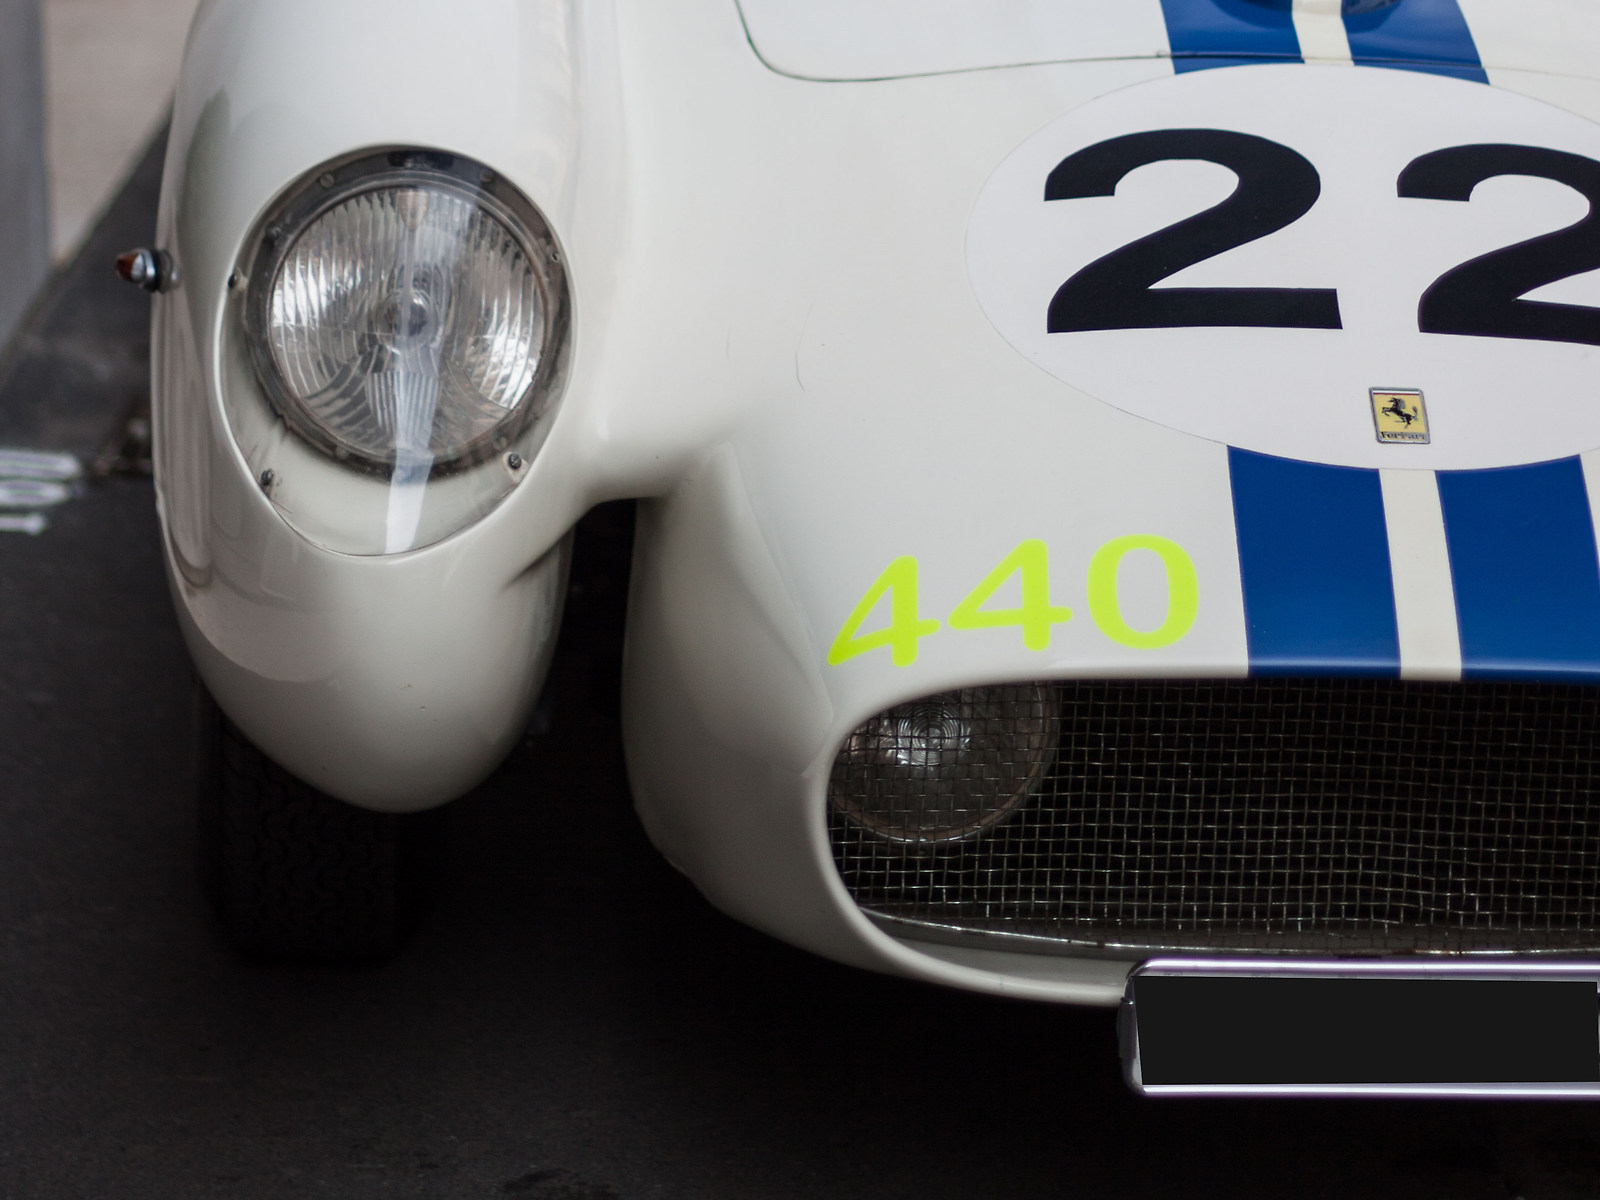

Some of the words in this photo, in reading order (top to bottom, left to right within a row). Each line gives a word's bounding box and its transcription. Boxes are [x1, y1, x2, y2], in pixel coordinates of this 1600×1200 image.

[1044, 128, 1600, 346] 22
[1379, 431, 1426, 440] Ferrari
[826, 533, 1199, 668] 440
